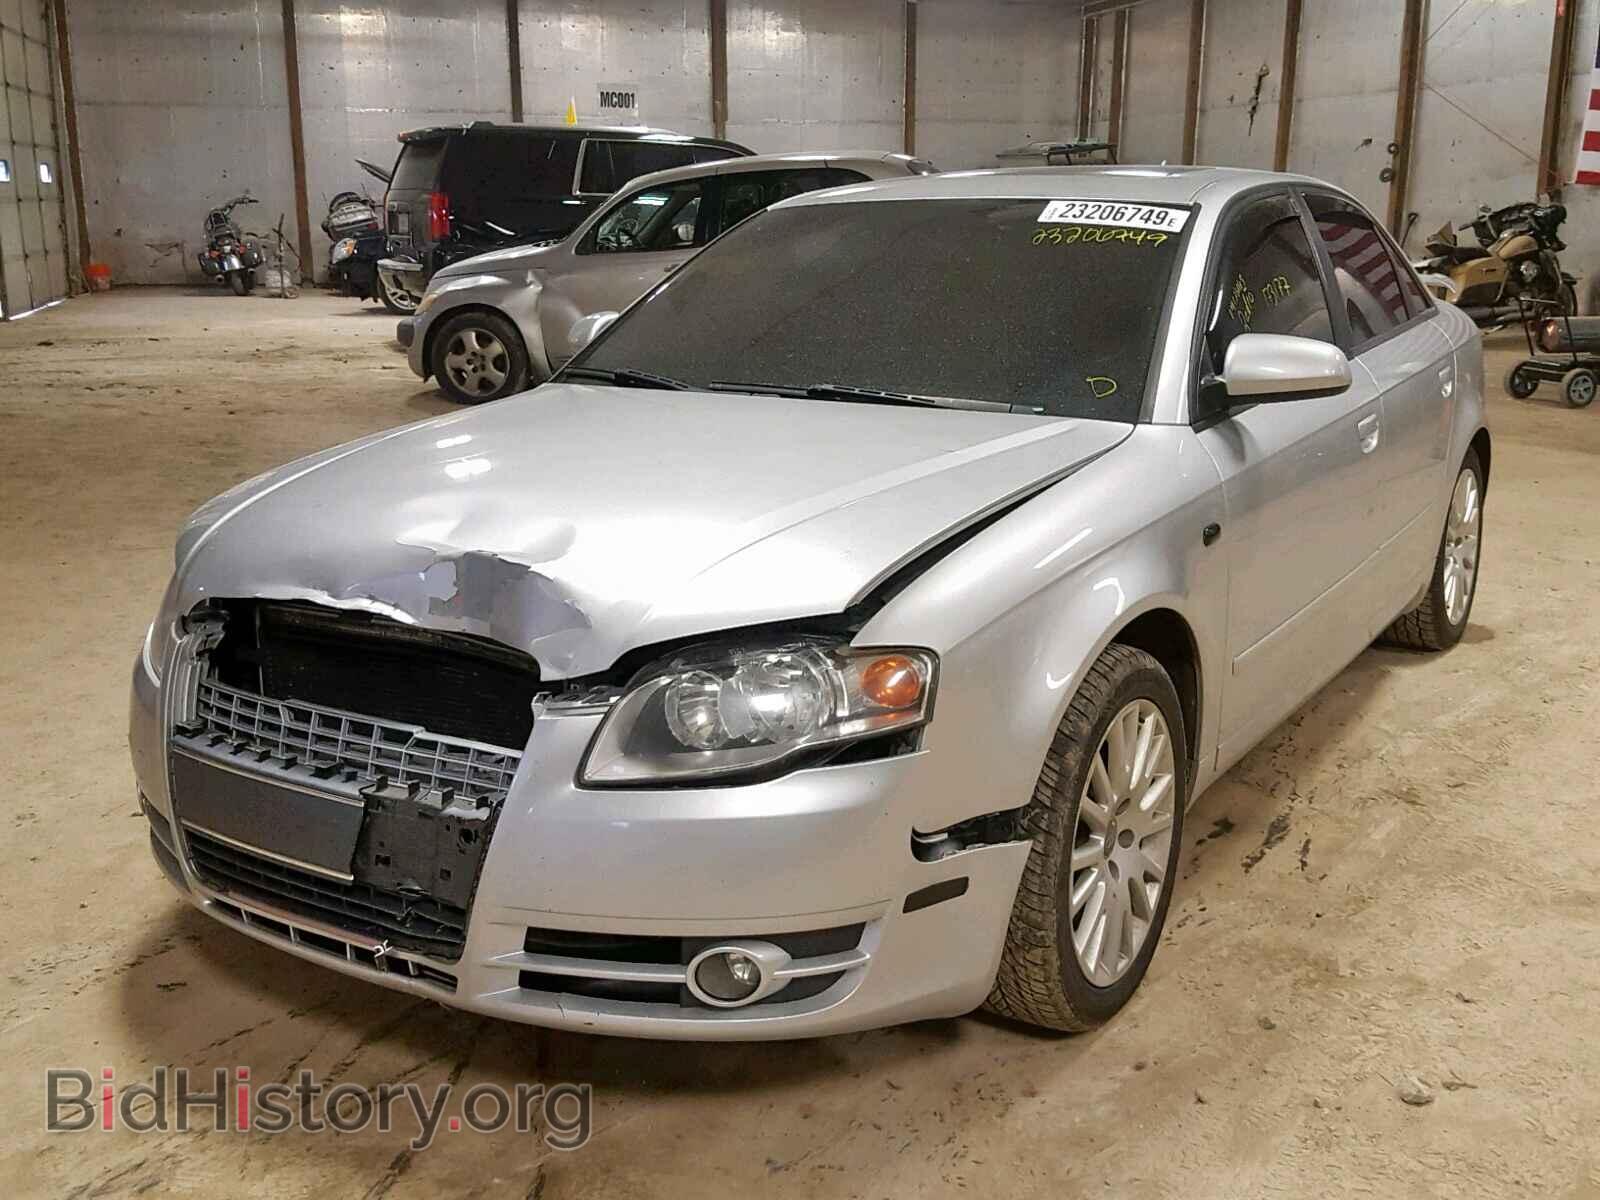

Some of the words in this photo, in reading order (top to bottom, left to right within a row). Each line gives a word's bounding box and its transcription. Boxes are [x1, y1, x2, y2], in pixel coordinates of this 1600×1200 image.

[600, 91, 635, 109] MC001
[1058, 203, 1169, 226] 23206749
[1032, 226, 1169, 248] 23206749
[1085, 376, 1117, 398] D
